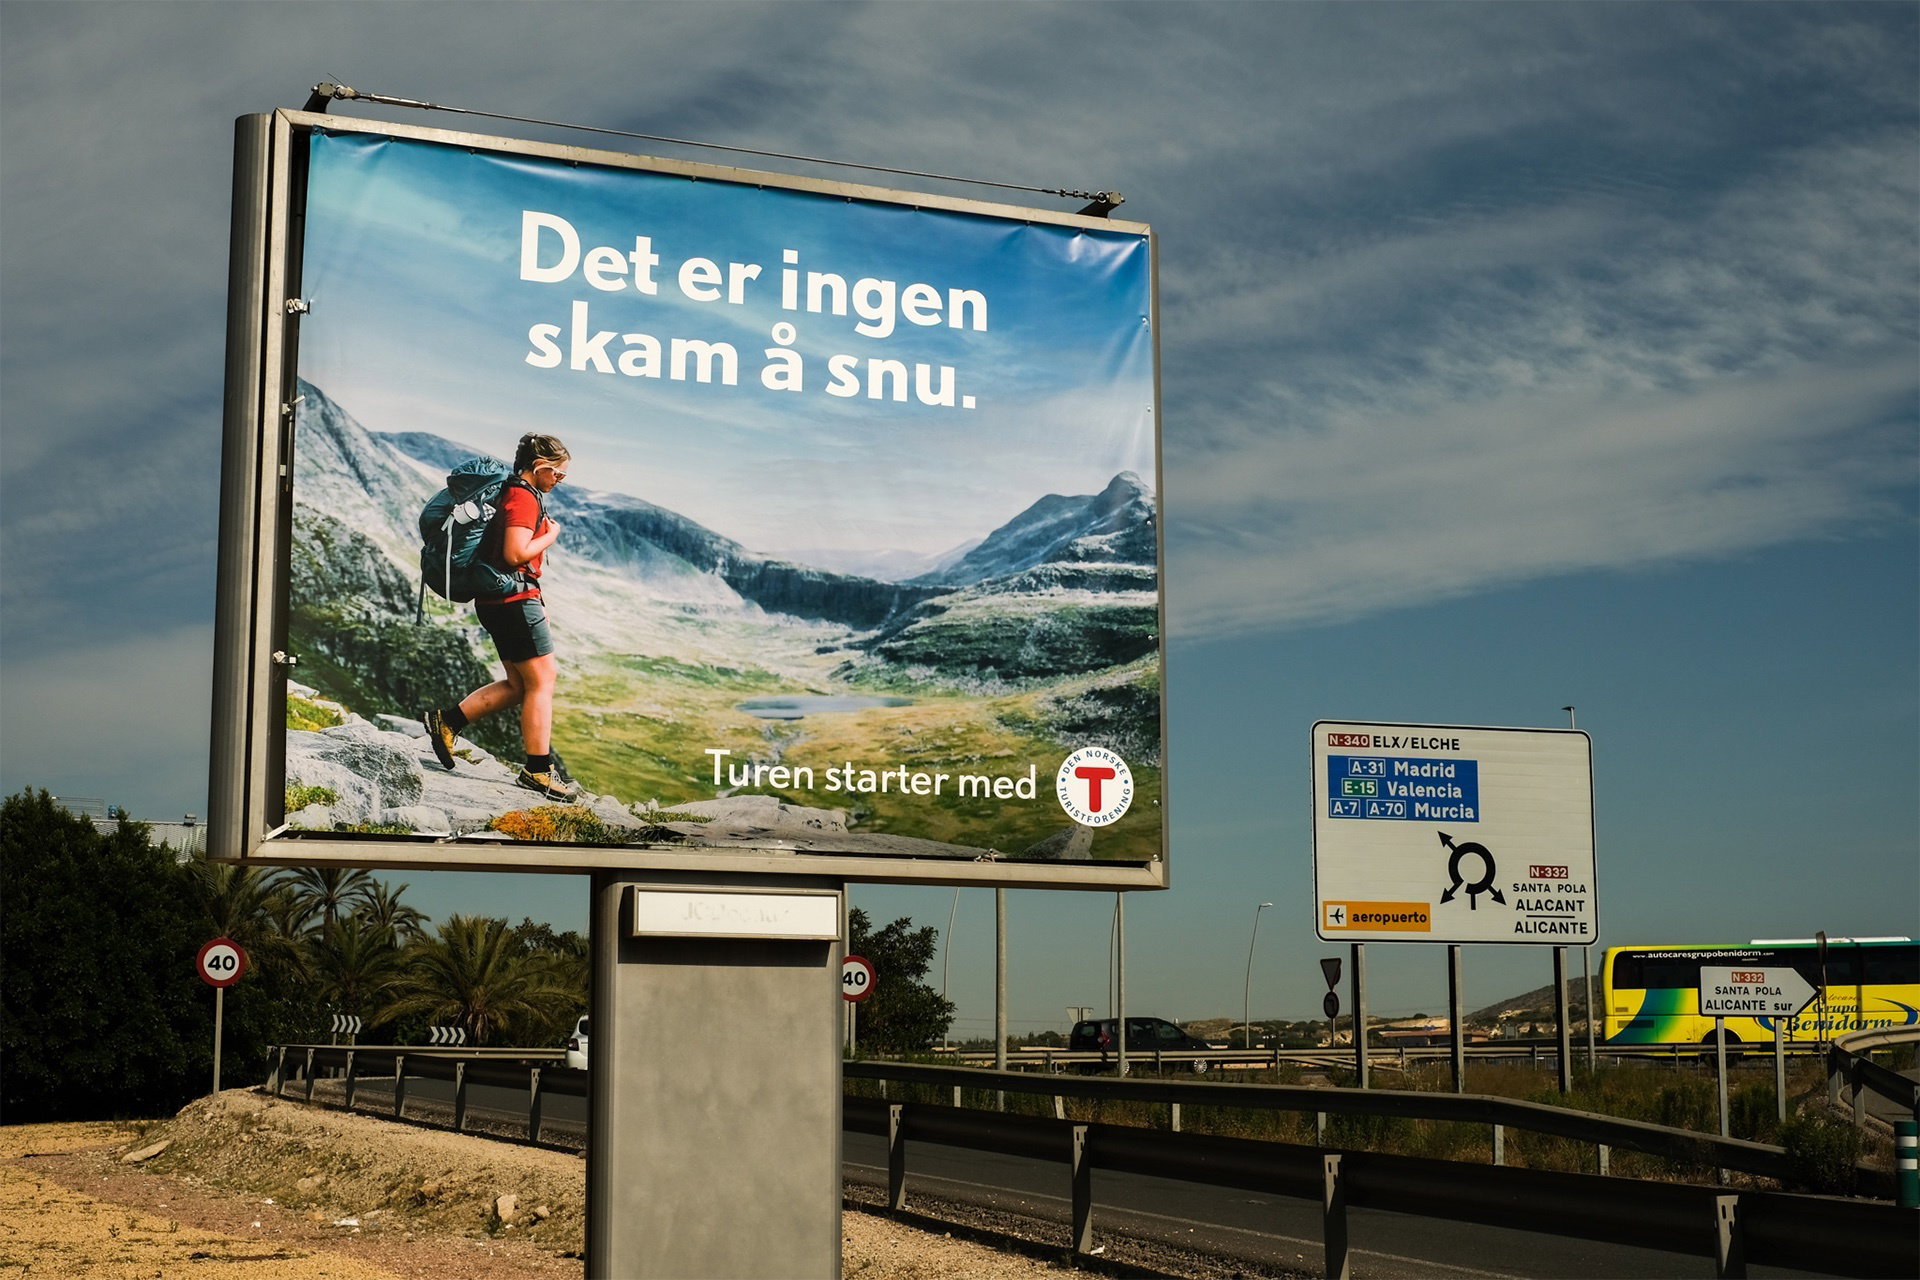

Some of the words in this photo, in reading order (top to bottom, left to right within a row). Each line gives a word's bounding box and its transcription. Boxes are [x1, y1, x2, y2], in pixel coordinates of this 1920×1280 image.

[520, 210, 659, 295] Det
[678, 256, 762, 304] er
[782, 249, 987, 338] ingen
[525, 300, 738, 386] skam
[760, 321, 803, 392] å
[825, 353, 976, 409] snu.
[1329, 734, 1369, 746] N-340
[1373, 736, 1460, 750] ELX/ELCHE
[1062, 754, 1081, 774] DEN
[1086, 750, 1127, 776] NORSKE
[1351, 760, 1384, 775] A-31
[1394, 761, 1455, 778] Madrid
[704, 748, 814, 790] Turen
[825, 762, 950, 796] starter
[959, 764, 1036, 799] med
[1075, 766, 1116, 812] T
[1344, 781, 1376, 794] E-15
[1387, 780, 1462, 798] Valencia
[1060, 786, 1131, 823] TURISTFORENING
[1333, 801, 1358, 814] A-7
[1369, 802, 1404, 815] A-70
[1415, 803, 1474, 819] Murcia
[1530, 866, 1567, 878] N-332
[1513, 883, 1551, 893] SANTA
[1557, 883, 1587, 894] POLA
[1516, 899, 1585, 912] ALACANT
[1352, 911, 1427, 925] aeropuerto
[1514, 921, 1588, 934] ALICANTE
[208, 955, 235, 971] 40
[842, 971, 866, 986] 40
[1732, 972, 1764, 982] N-332
[1715, 986, 1750, 995] SANTA
[1755, 986, 1782, 996] POLA
[1705, 1000, 1766, 1011] ALICANTE
[1773, 1002, 1793, 1011] sur
[1784, 1014, 1892, 1032] Benidorm
